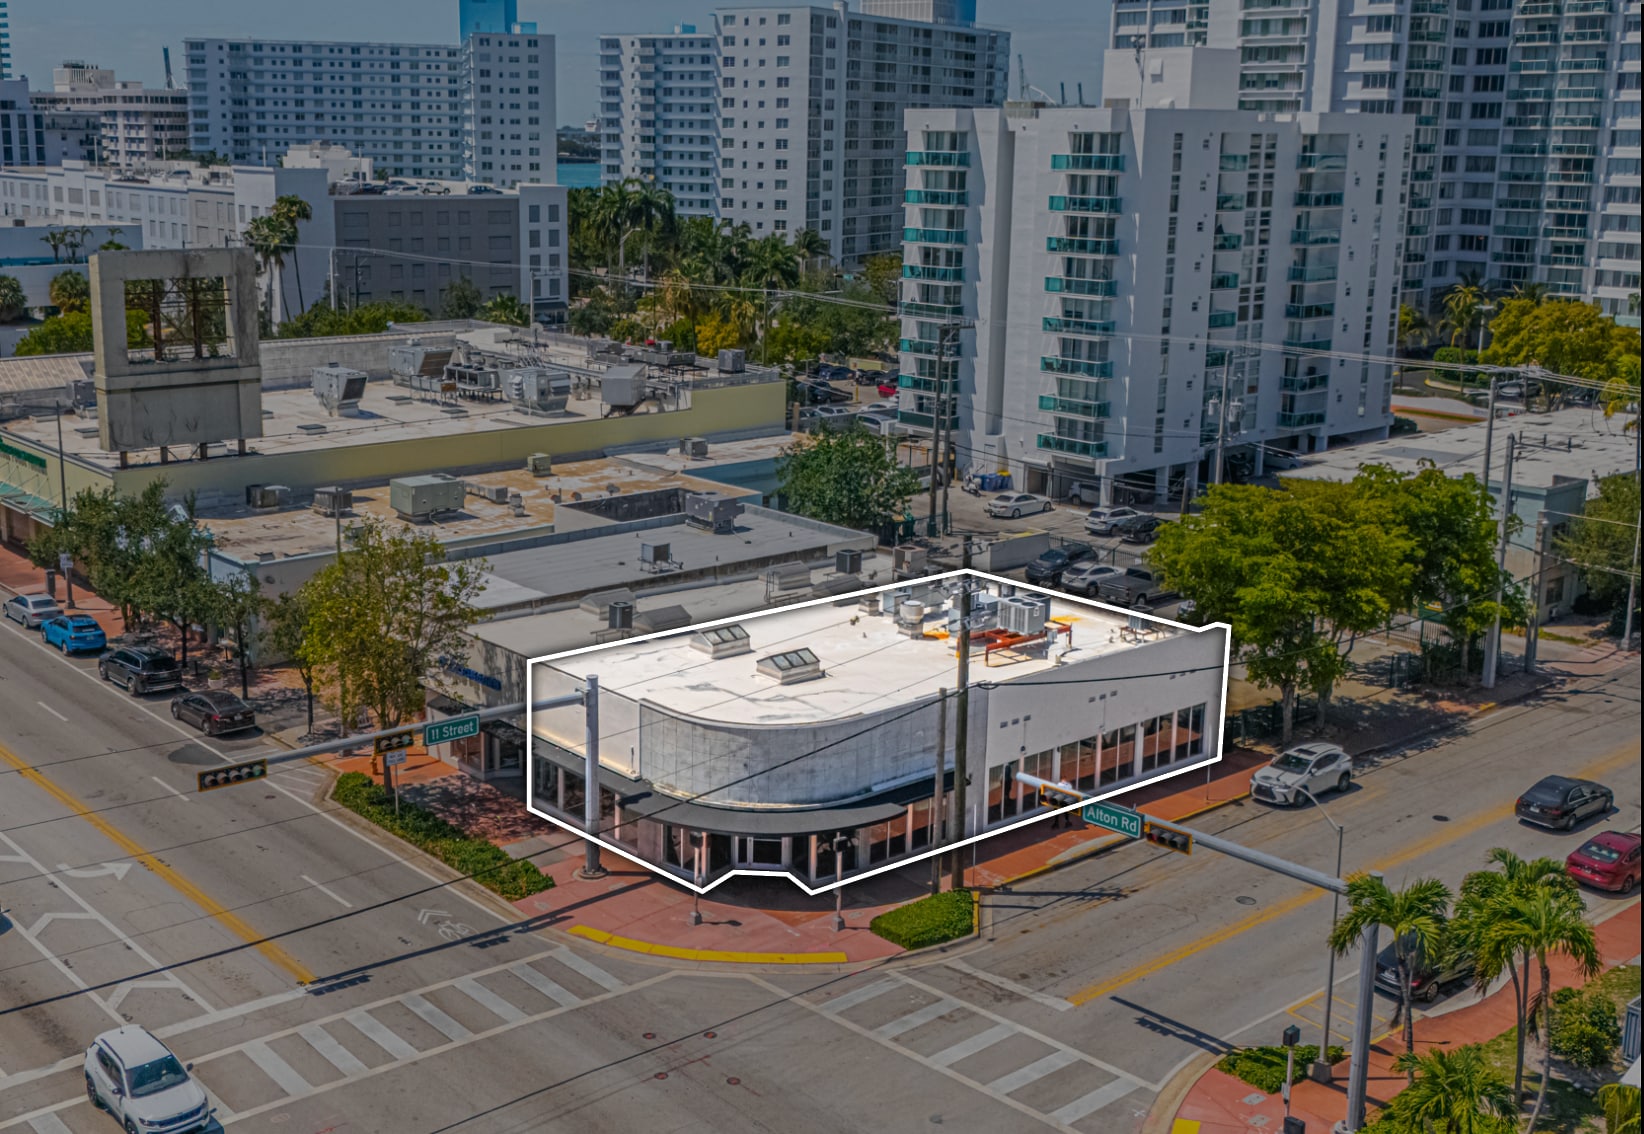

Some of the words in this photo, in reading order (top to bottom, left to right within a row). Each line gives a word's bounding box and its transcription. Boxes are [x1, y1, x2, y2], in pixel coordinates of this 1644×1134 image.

[431, 729, 439, 740] 11
[442, 721, 474, 737] Street
[1087, 806, 1118, 826] Alton
[1121, 816, 1137, 832] Rd
